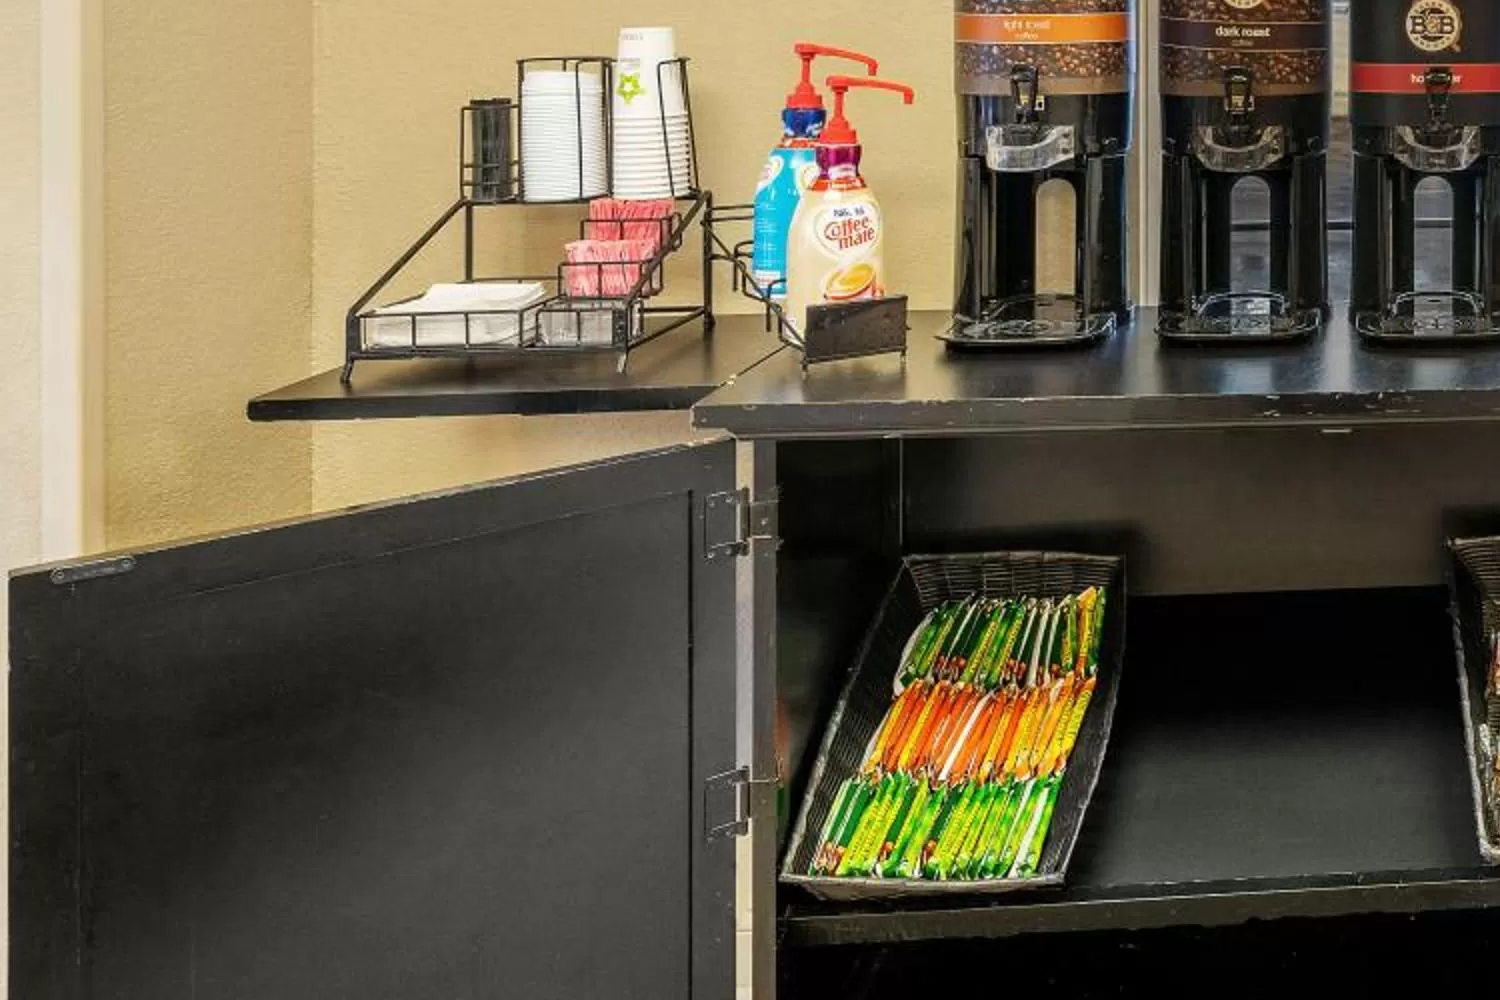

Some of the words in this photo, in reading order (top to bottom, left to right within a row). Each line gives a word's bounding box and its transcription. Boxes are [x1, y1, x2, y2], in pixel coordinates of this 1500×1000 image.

[1215, 25, 1240, 37] dark
[1241, 26, 1271, 37] roast
[839, 227, 875, 250] mate
